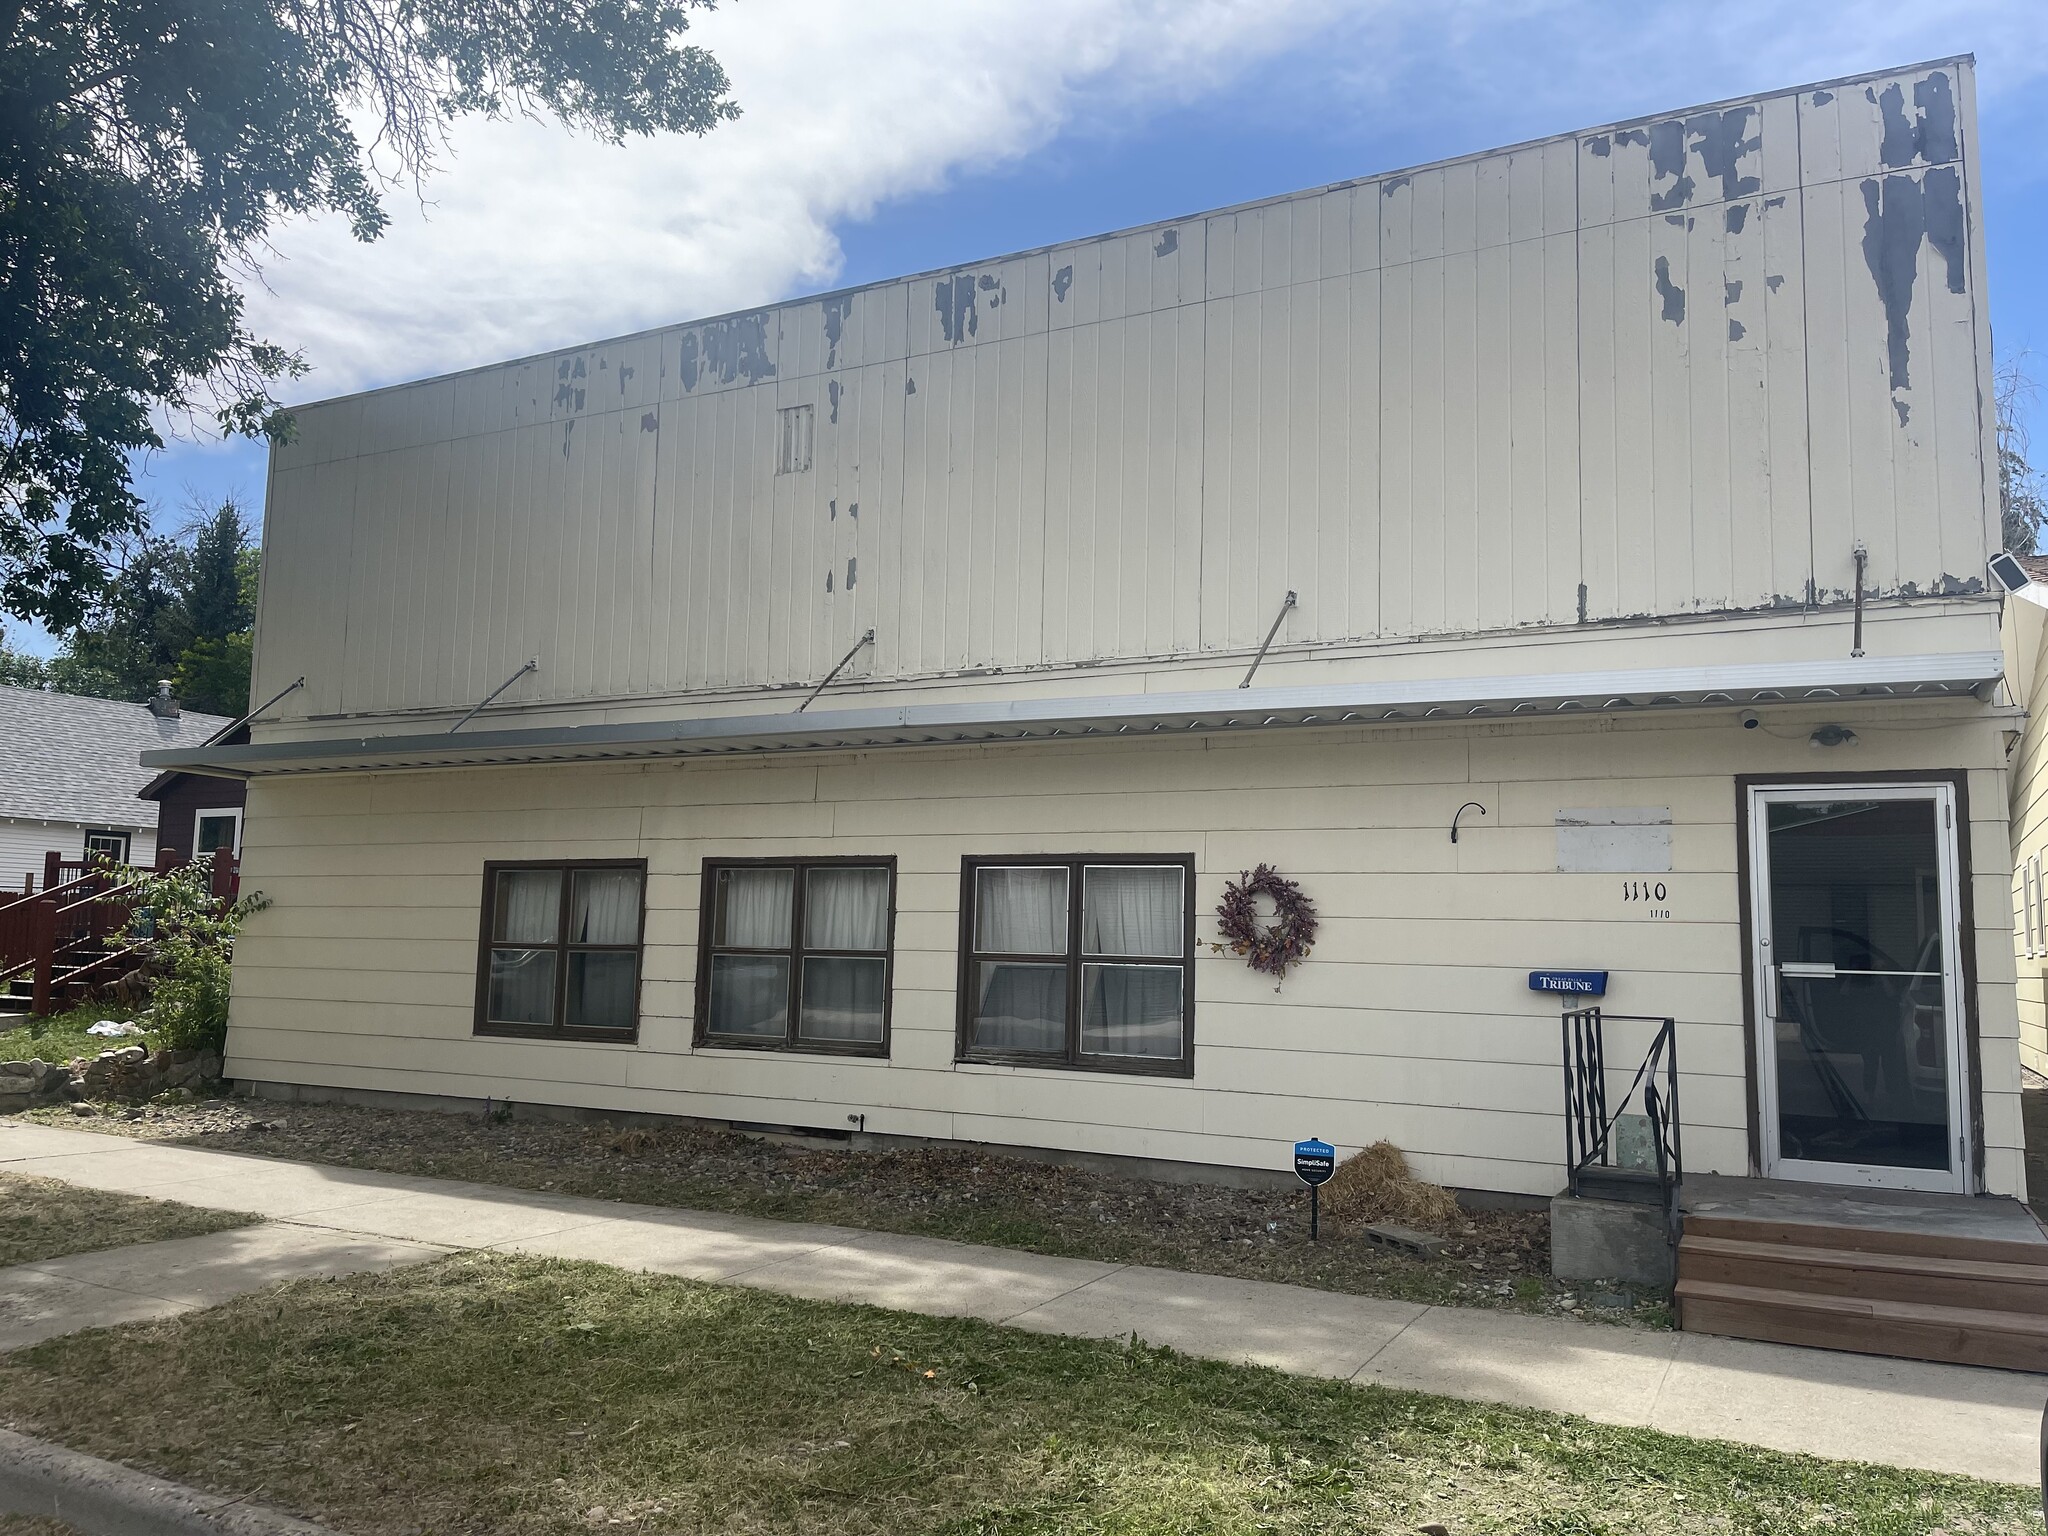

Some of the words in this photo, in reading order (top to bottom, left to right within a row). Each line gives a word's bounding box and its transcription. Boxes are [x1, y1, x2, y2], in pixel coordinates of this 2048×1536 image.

[1623, 881, 1667, 901] 1110
[1650, 909, 1670, 919] 1110
[1539, 976, 1592, 991] TRIBUNE
[1297, 1158, 1330, 1167] SimpliSafe
